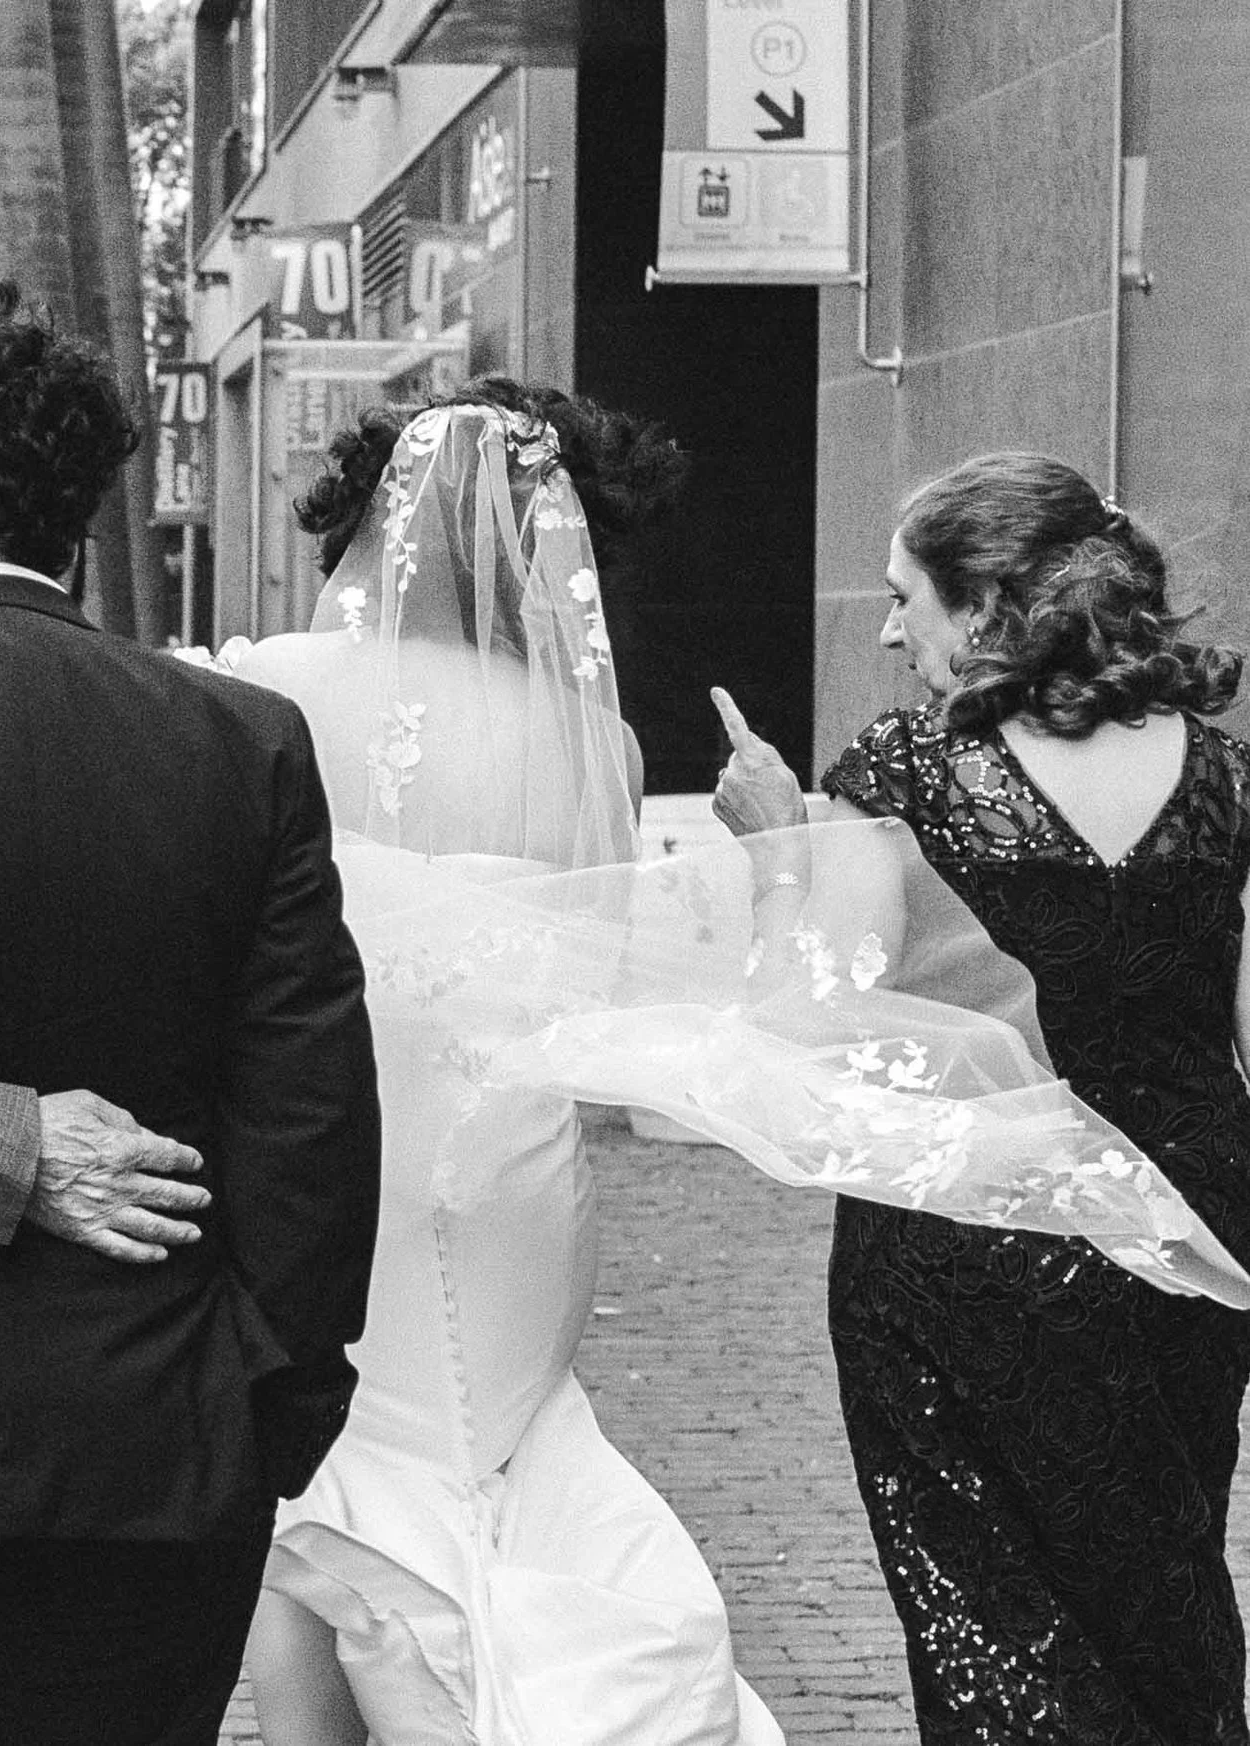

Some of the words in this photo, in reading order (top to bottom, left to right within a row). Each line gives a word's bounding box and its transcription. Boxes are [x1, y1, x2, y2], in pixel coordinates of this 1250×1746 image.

[762, 37, 795, 61] P1
[270, 239, 349, 314] 70
[155, 372, 208, 424] 70
